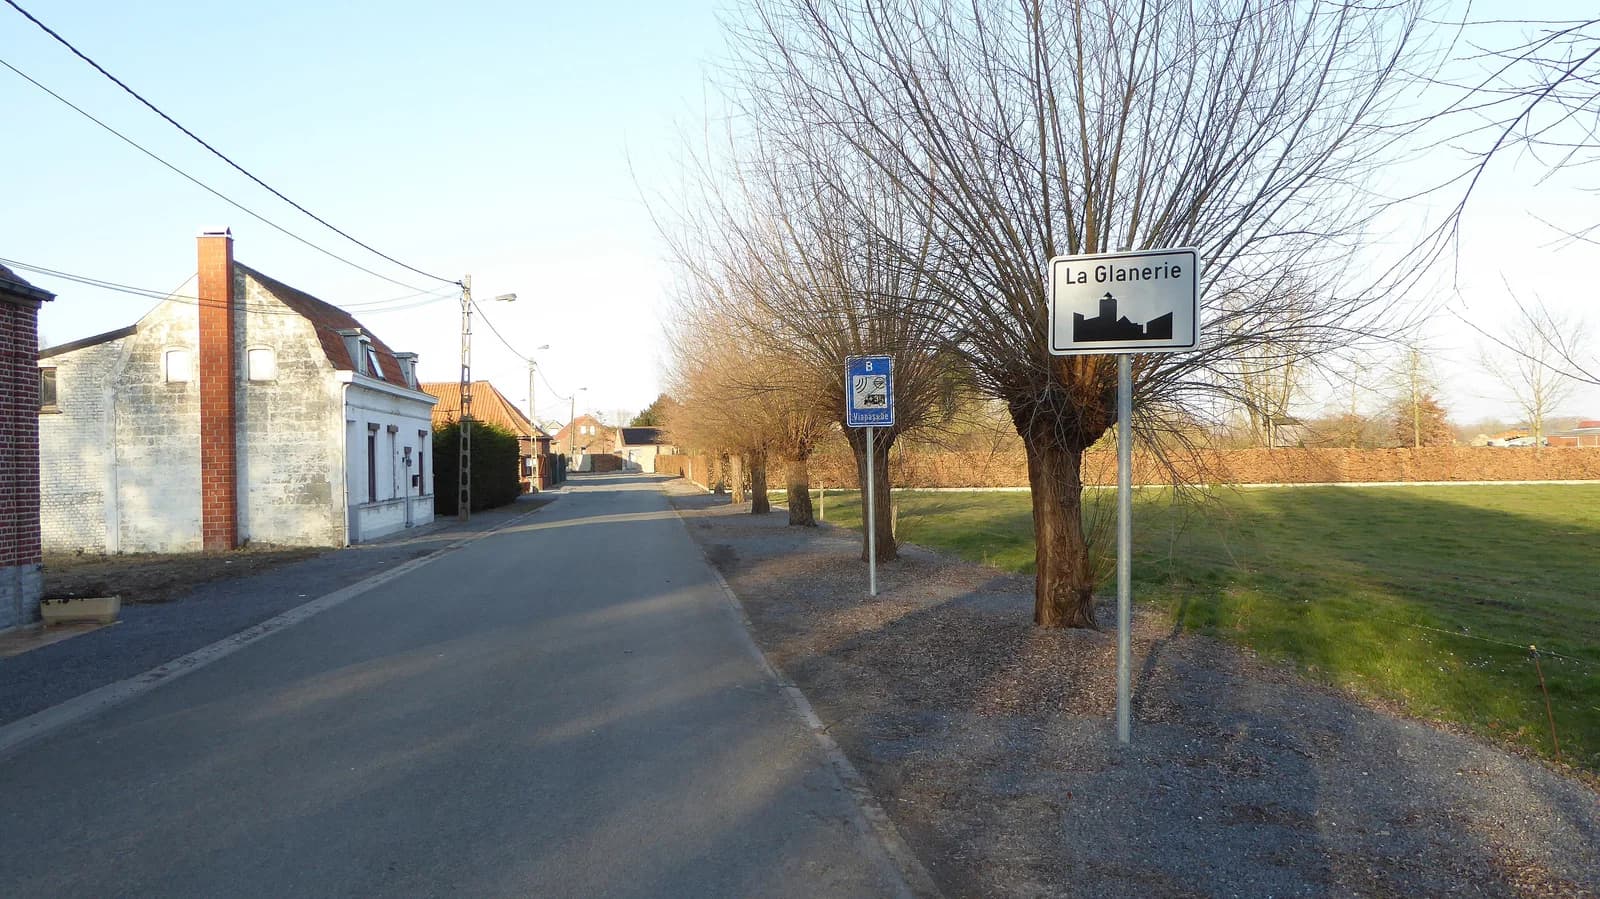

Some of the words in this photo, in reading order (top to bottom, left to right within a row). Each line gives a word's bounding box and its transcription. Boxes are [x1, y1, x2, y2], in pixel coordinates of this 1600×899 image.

[1066, 267, 1087, 285] La
[1095, 261, 1182, 284] Glanerie
[865, 361, 873, 371] B
